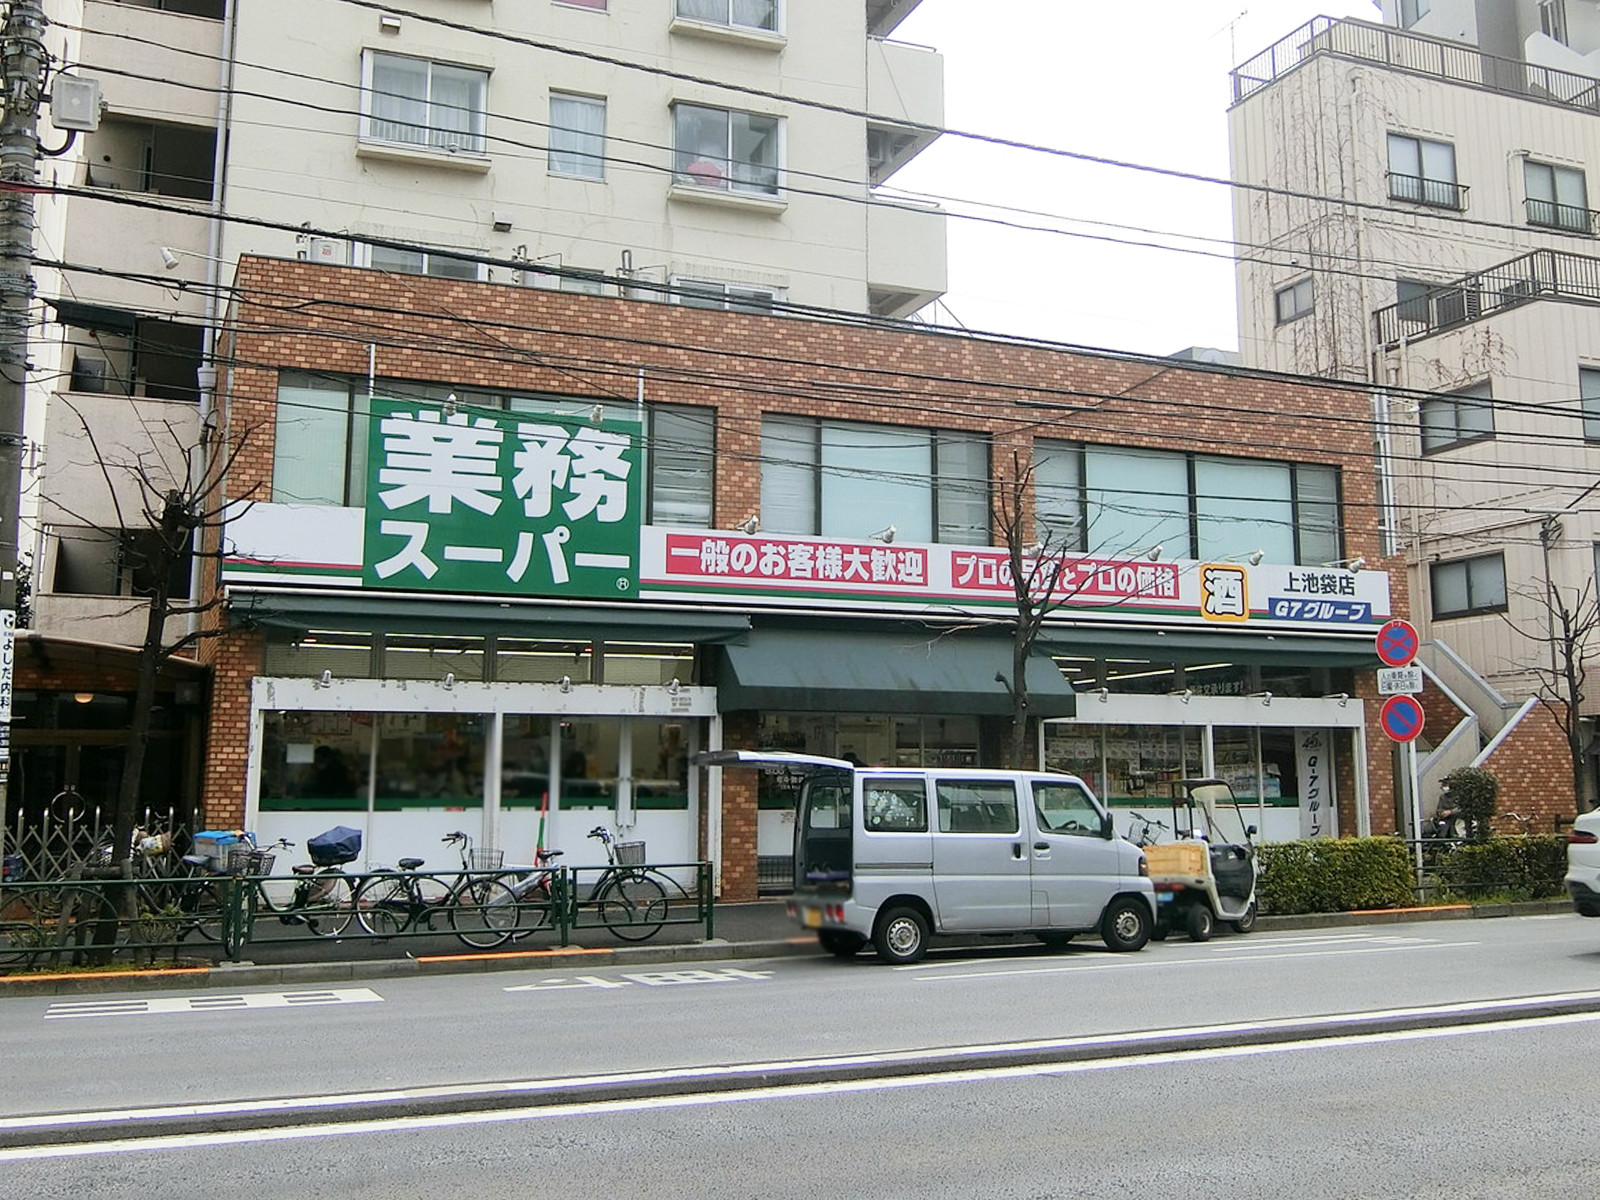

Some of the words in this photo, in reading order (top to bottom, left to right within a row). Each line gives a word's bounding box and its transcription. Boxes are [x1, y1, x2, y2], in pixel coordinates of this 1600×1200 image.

[379, 410, 632, 523] 業務
[374, 520, 631, 584] スーパー
[671, 538, 924, 583] 一般のお客様大歓迎
[1203, 568, 1244, 616] 酒
[1284, 571, 1355, 596] 上池袋店
[1275, 600, 1366, 621] G7グループ
